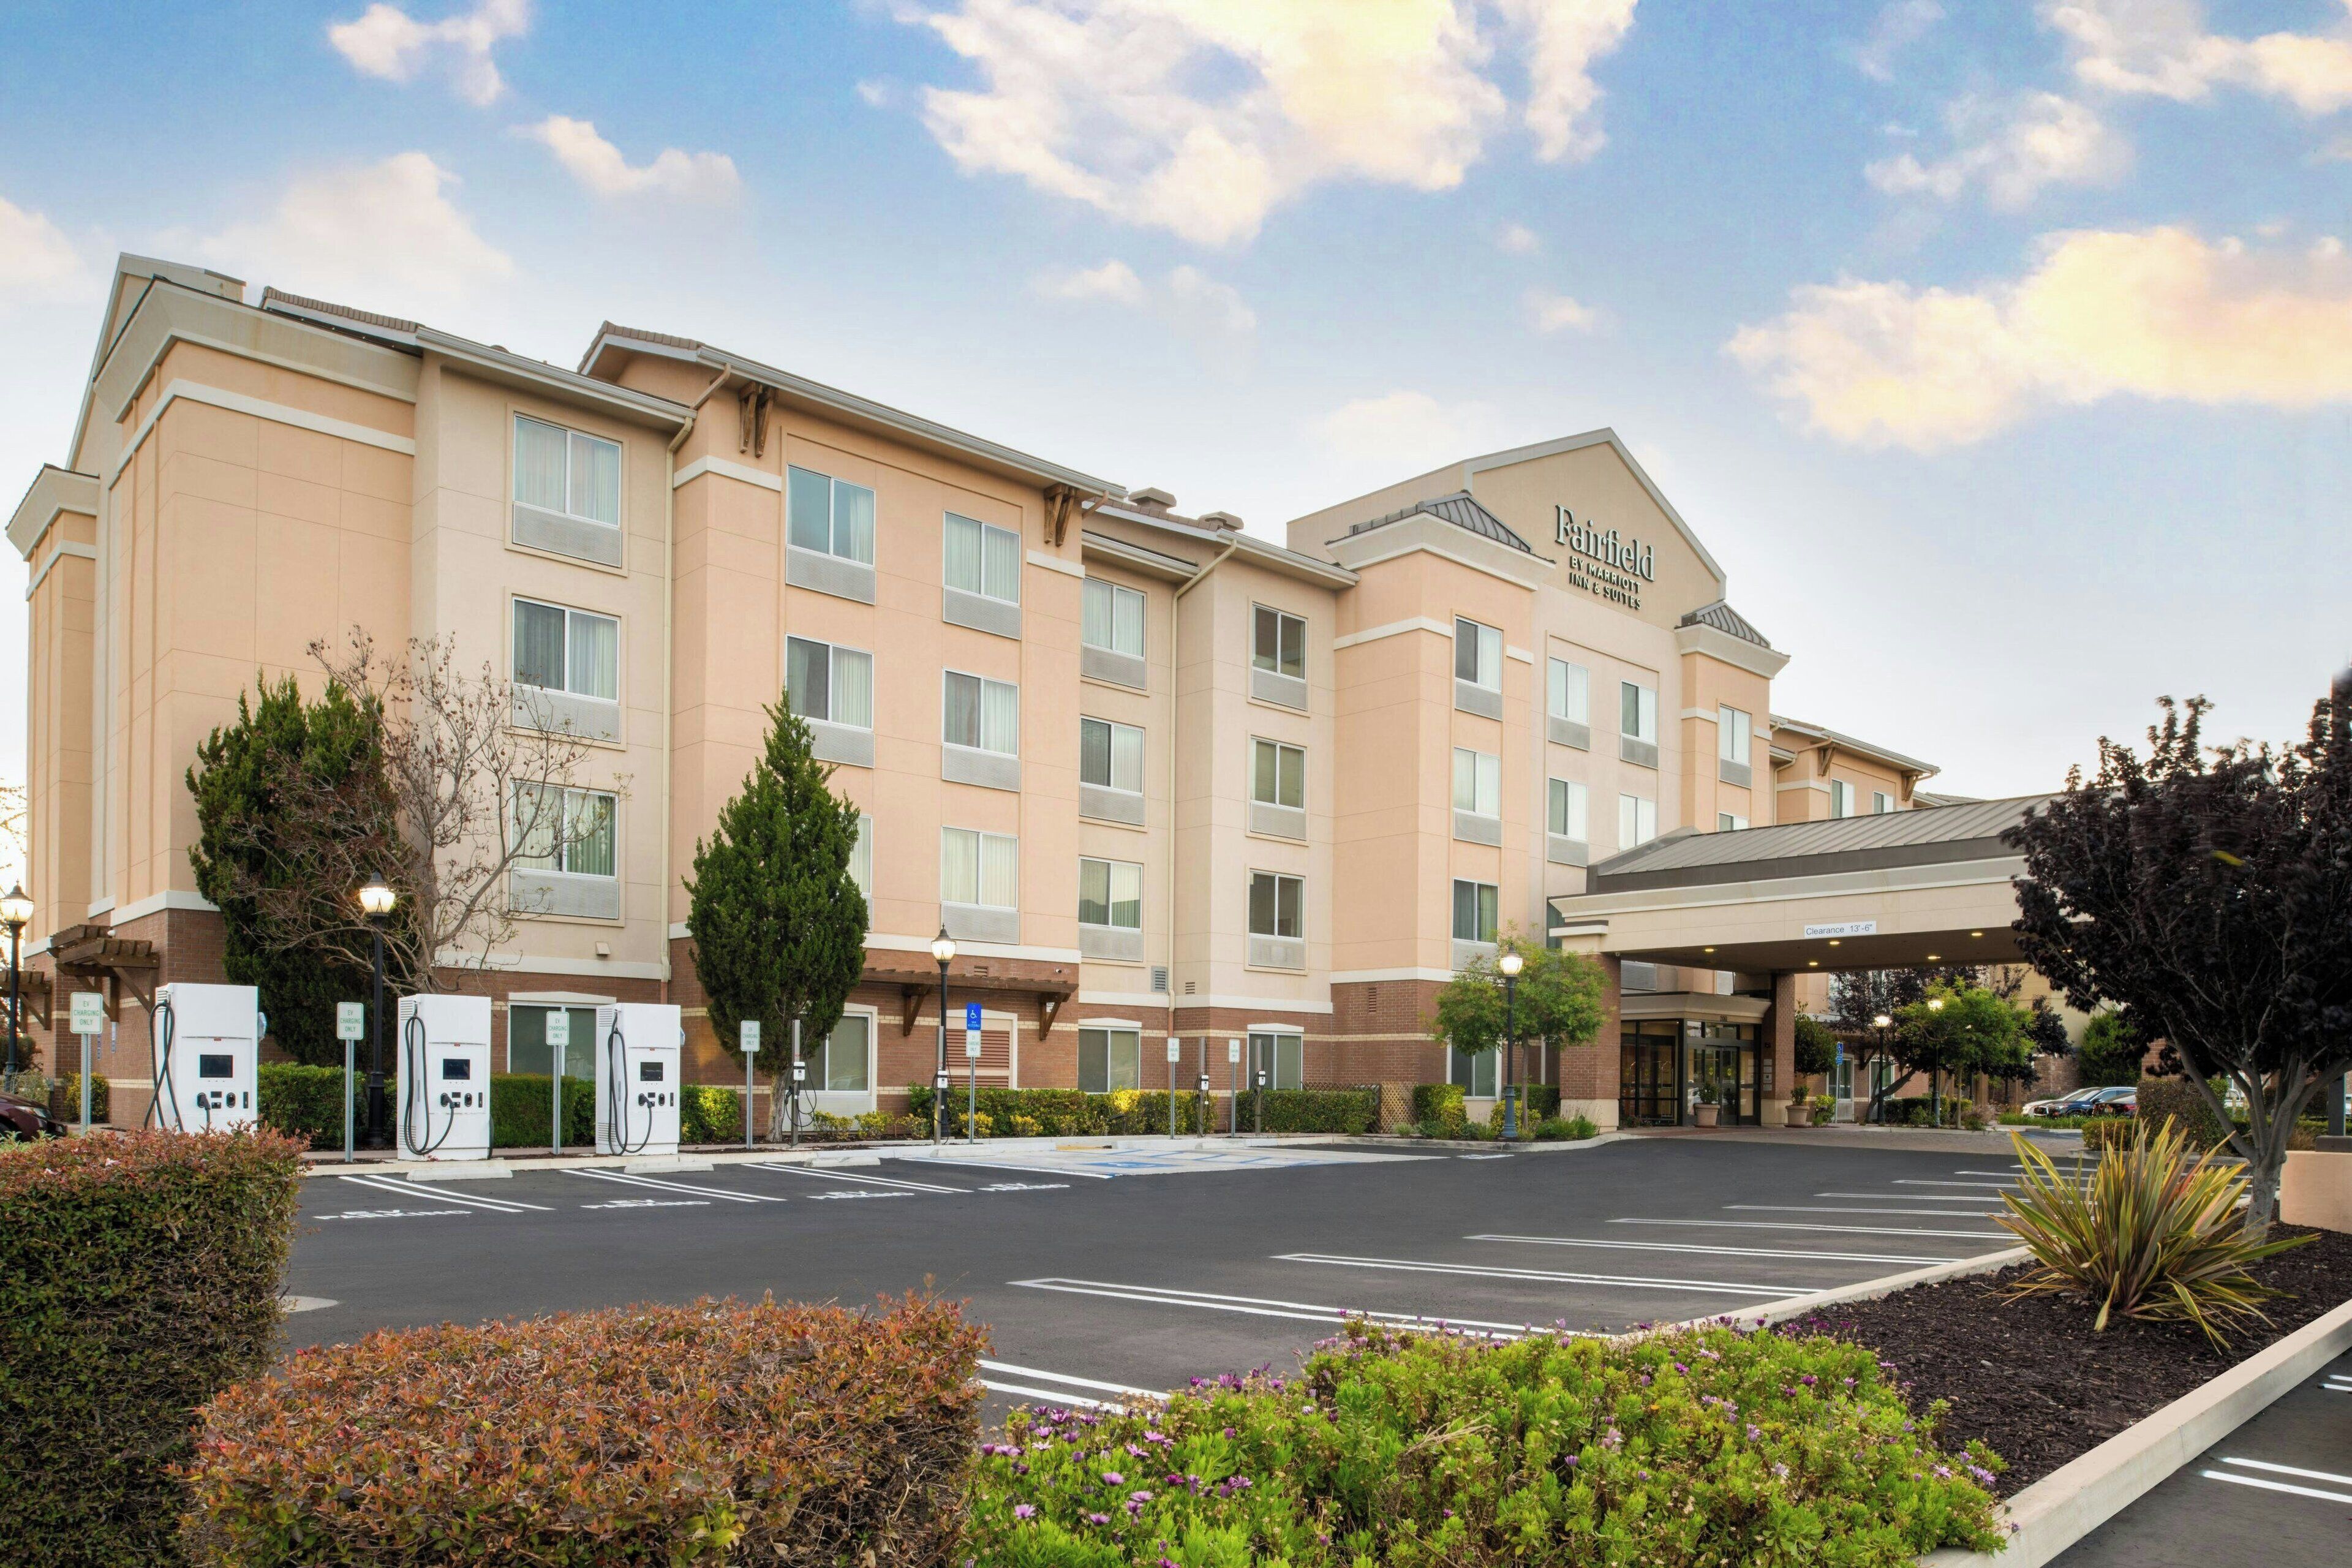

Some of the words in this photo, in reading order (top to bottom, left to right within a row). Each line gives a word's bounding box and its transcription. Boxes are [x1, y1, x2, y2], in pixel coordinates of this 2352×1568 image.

[1555, 504, 1655, 582] Fairfield
[1569, 572, 1589, 590] INN
[1592, 581, 1600, 594] &
[1603, 585, 1642, 610] SUITES
[1570, 556, 1585, 571] BY
[1587, 562, 1642, 594] MARRIOTT
[1806, 926, 1844, 935] Clearance
